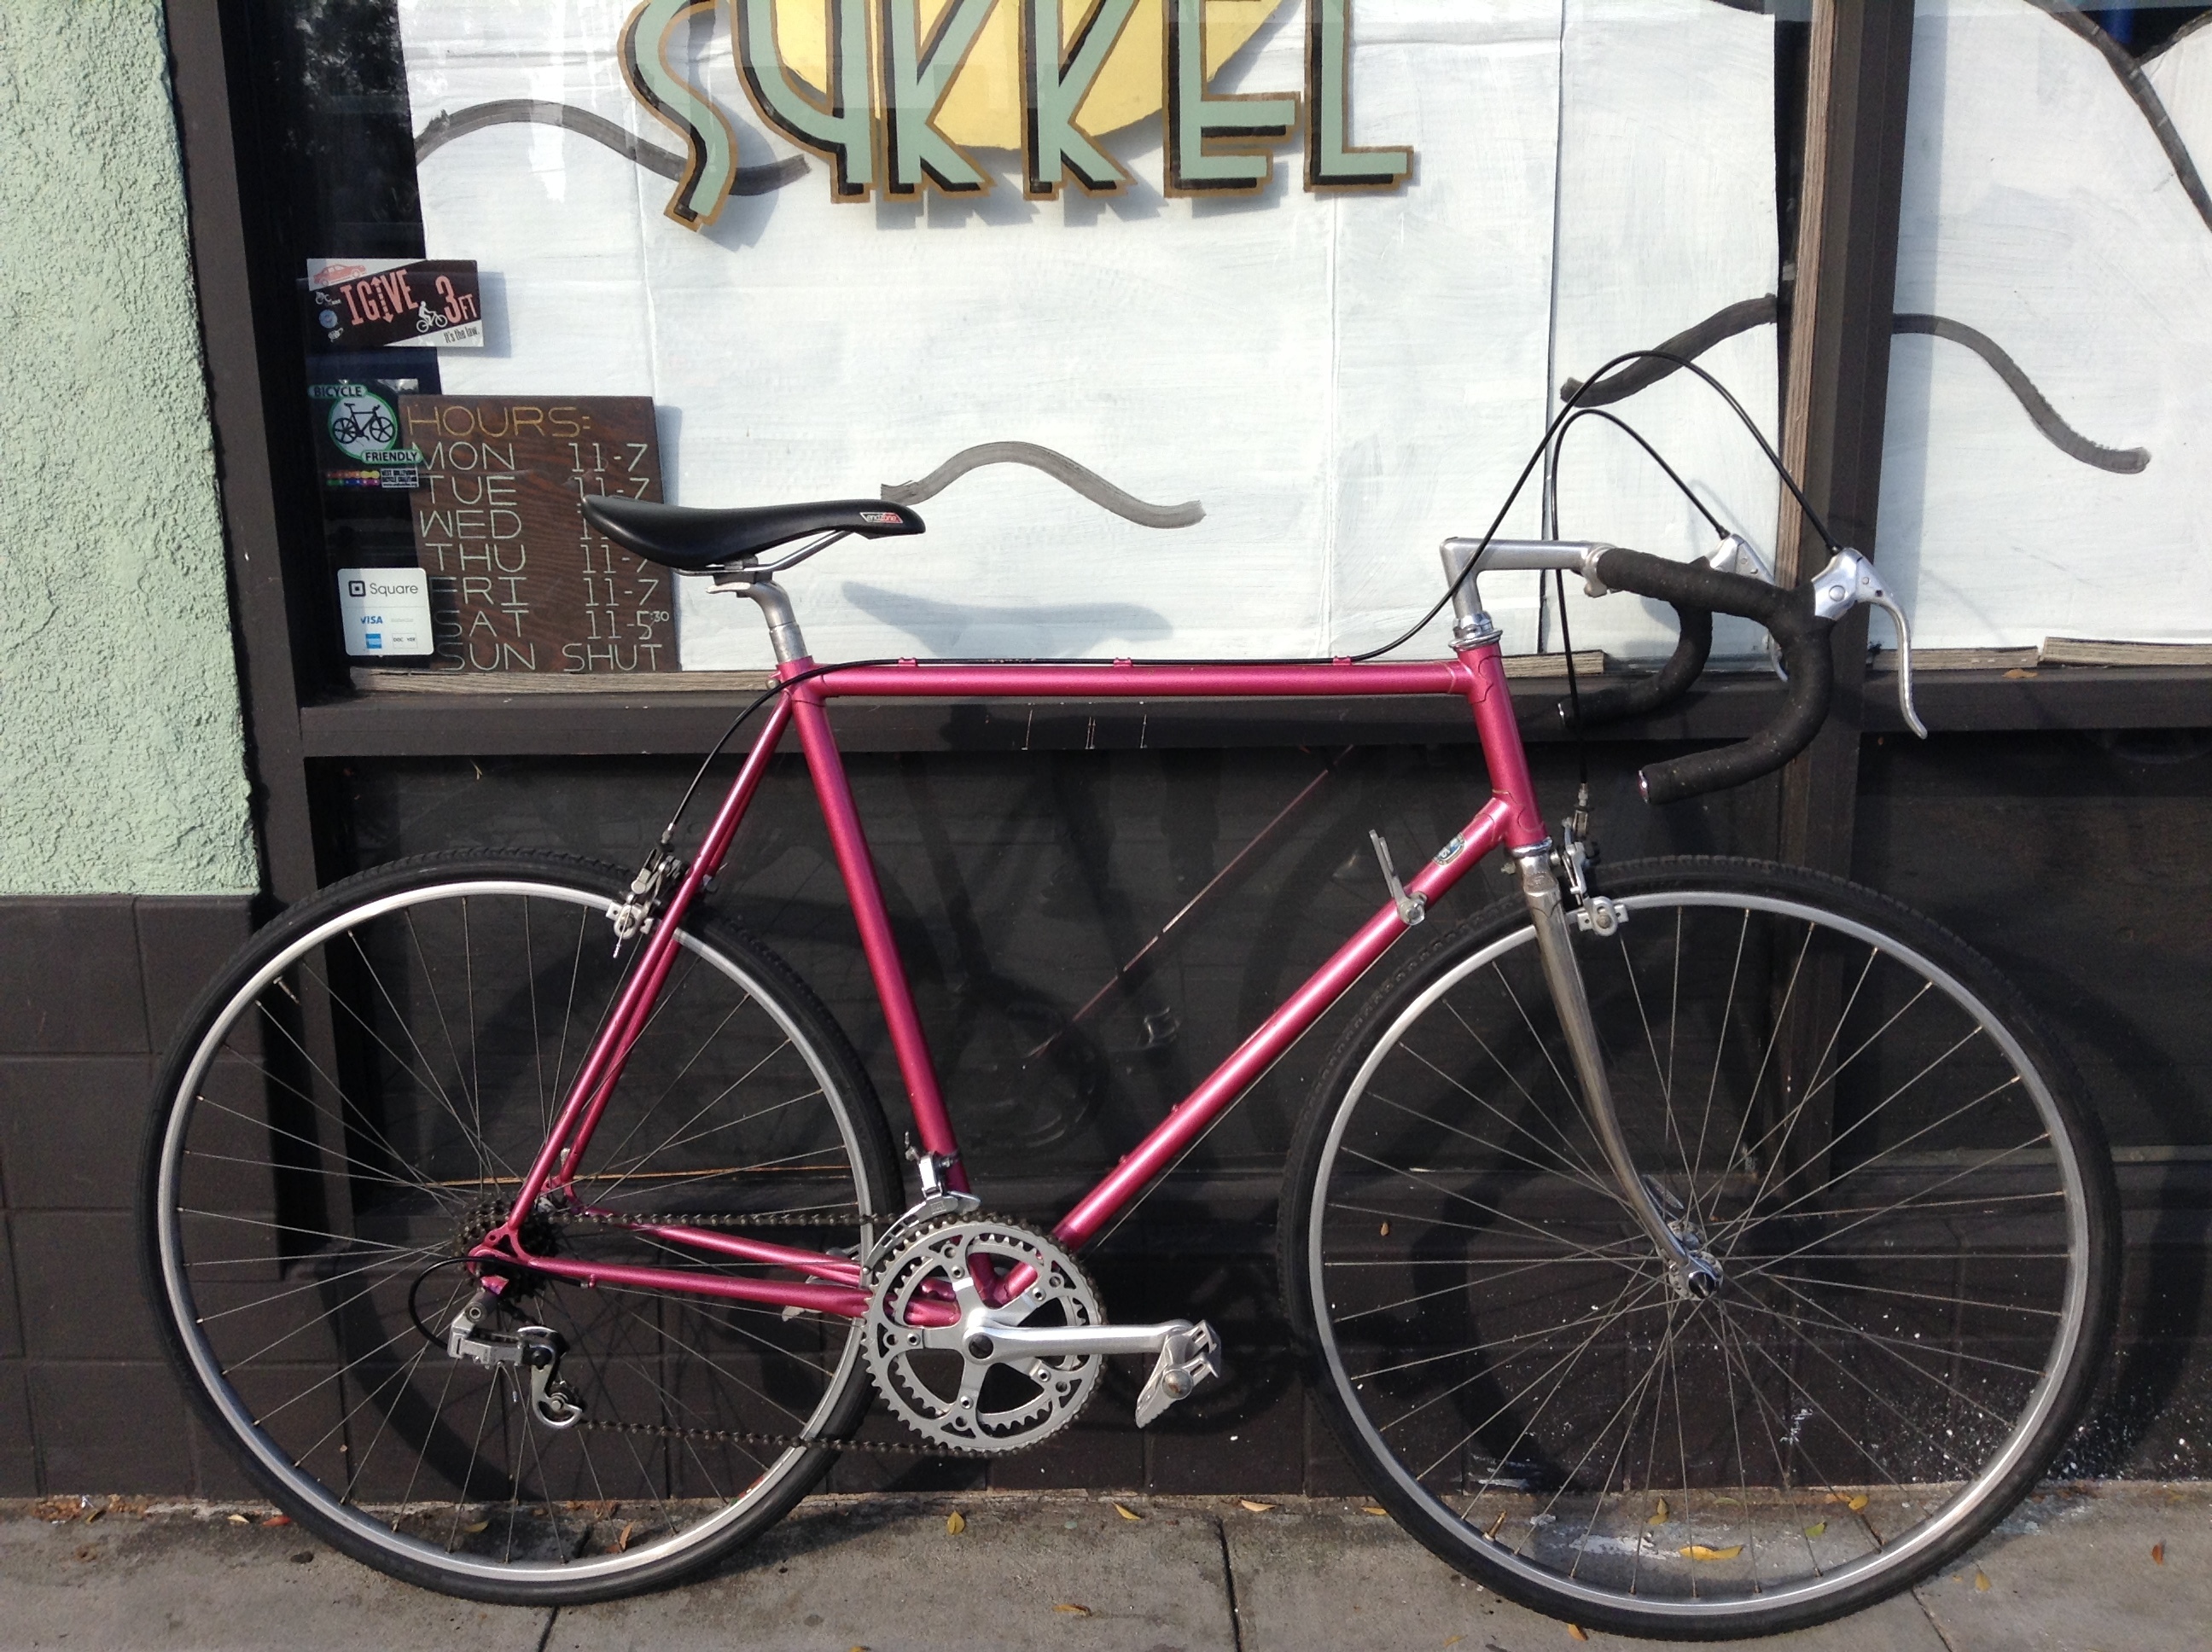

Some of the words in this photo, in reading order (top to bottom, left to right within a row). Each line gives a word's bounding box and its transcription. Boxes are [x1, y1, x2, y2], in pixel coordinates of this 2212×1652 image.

[314, 387, 363, 398] BICYCLE
[407, 405, 591, 437] HOURS:
[365, 451, 418, 462] FRIENDLY
[412, 441, 515, 470] MON
[419, 475, 517, 505] TUE
[420, 509, 522, 538] WED
[425, 543, 527, 572] THU
[370, 583, 419, 596] Square
[428, 576, 529, 605] FRI
[360, 615, 383, 625] VISA
[434, 609, 530, 638] SAT
[437, 643, 537, 671] SUN
[562, 643, 663, 672] SHUT
